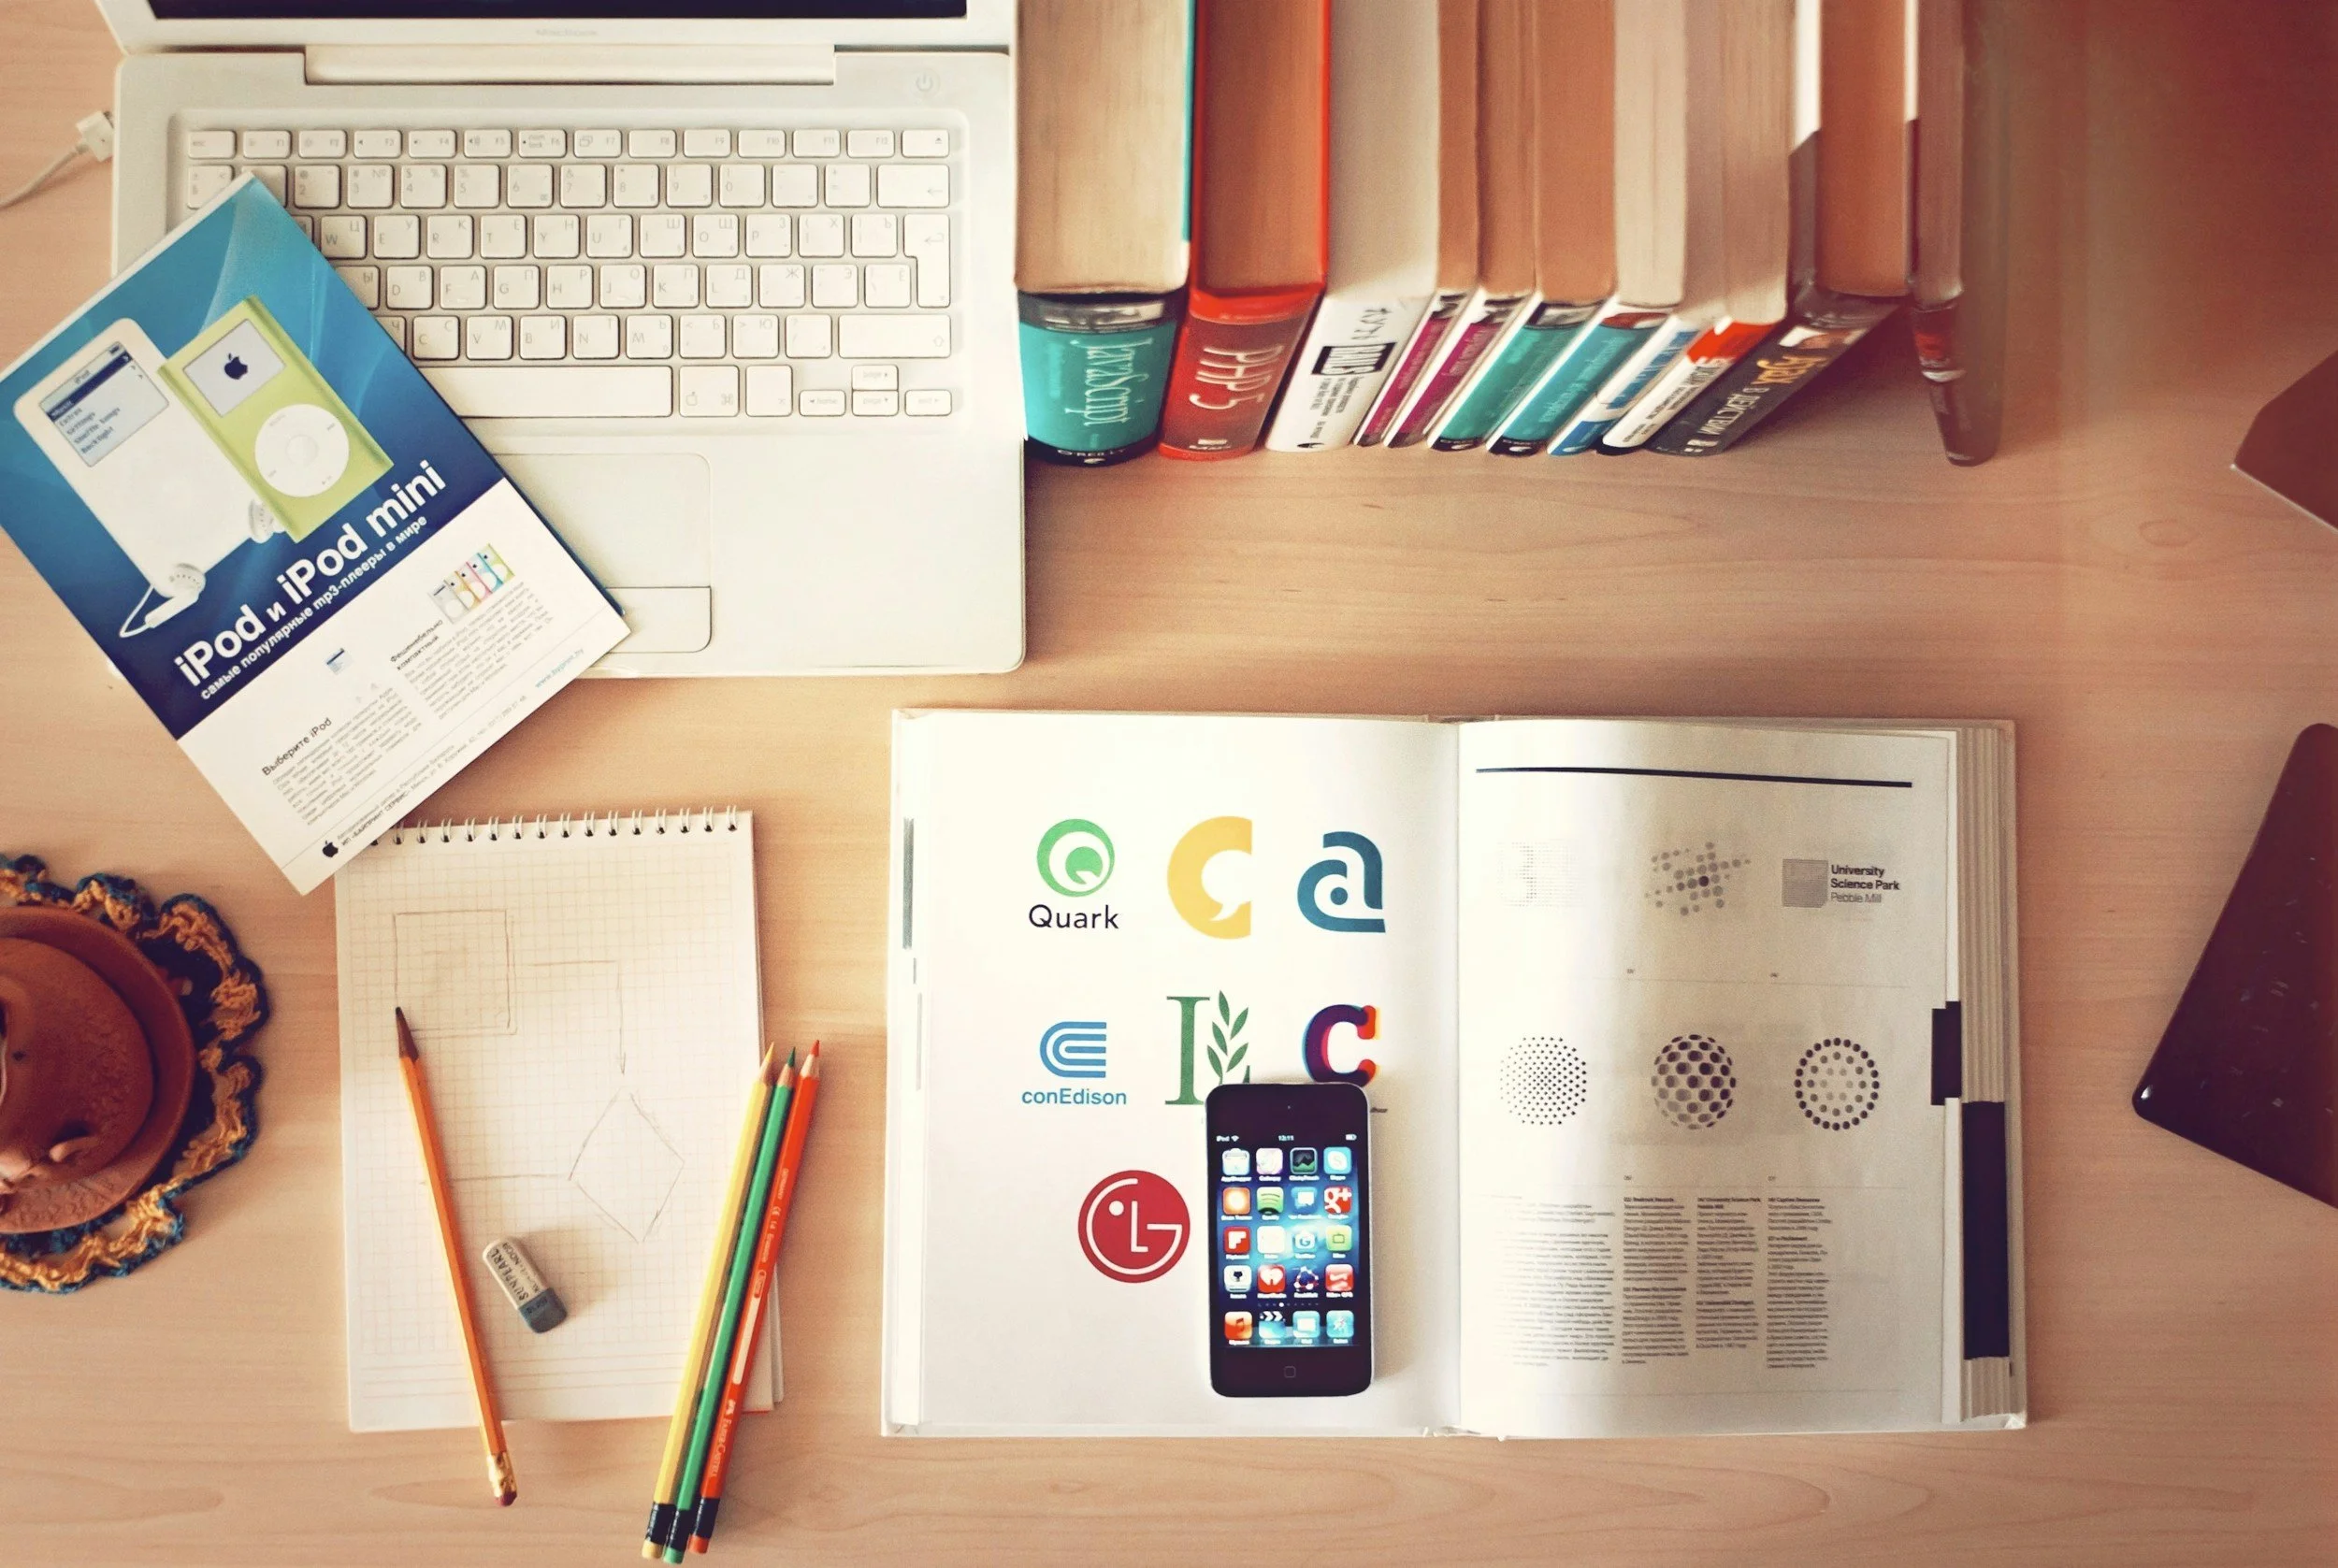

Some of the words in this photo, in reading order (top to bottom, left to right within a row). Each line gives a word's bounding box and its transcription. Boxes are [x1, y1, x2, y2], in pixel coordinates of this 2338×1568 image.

[1064, 338, 1154, 426] JavaScript
[175, 604, 266, 685] iPod
[266, 601, 286, 622] и
[278, 523, 368, 603] iPod
[367, 460, 445, 537] mini
[201, 665, 241, 699] самые
[240, 607, 313, 668] популярные
[313, 549, 386, 610] mp3-плееры
[385, 541, 396, 552] в
[395, 516, 427, 544] мире
[390, 620, 443, 662] Фешенебельно
[397, 635, 439, 671] компактный
[261, 737, 310, 776] Выберите
[310, 717, 332, 738] iPod
[1830, 864, 1885, 878] University
[1830, 879, 1873, 890] Science
[1875, 880, 1900, 891] Park
[1029, 903, 1119, 930] Quark
[1830, 892, 1864, 903] Pebble
[1865, 893, 1883, 904] Mill
[1021, 1087, 1128, 1106] conEdison
[1085, 1177, 1184, 1276] LG
